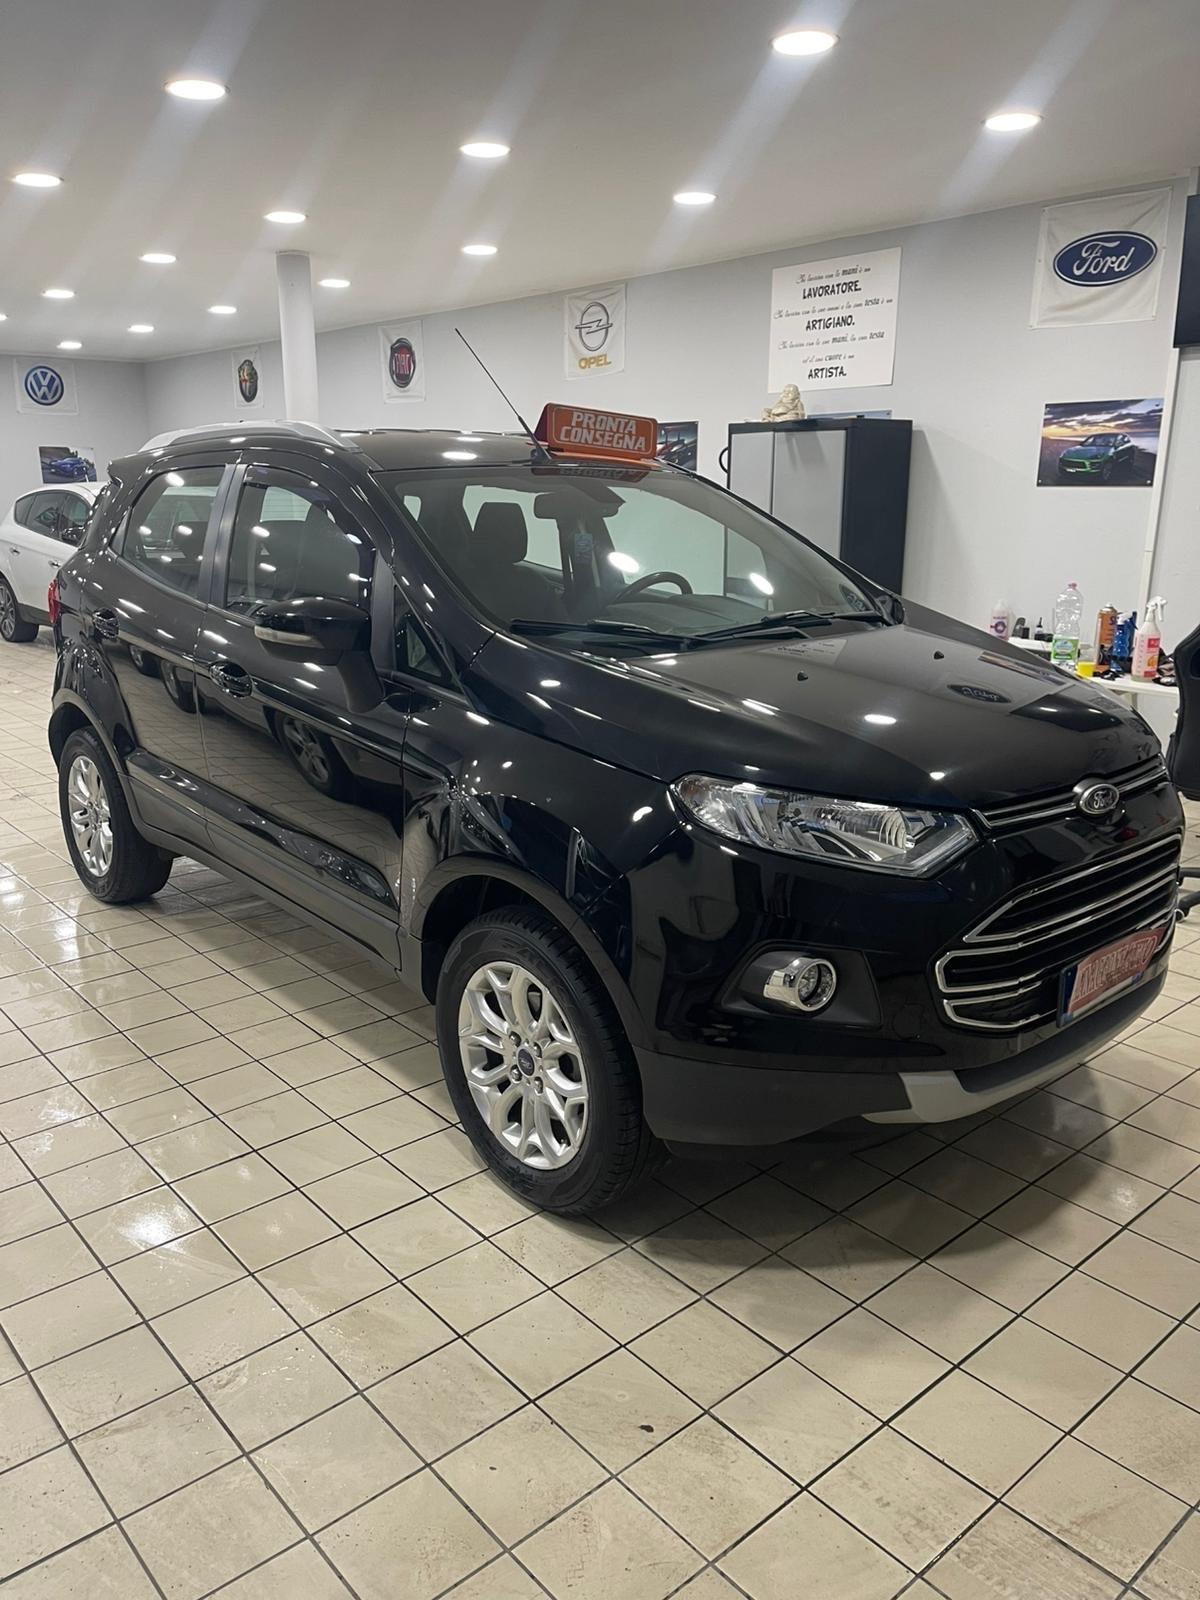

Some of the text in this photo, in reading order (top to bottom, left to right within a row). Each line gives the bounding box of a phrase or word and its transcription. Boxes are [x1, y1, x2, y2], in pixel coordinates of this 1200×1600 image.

[1073, 240, 1135, 276] Ford
[802, 280, 862, 300] LAVORATORE.
[805, 315, 855, 332] ARTIGIANO.
[393, 353, 411, 375] FIAT
[579, 354, 612, 369] OPEL
[807, 366, 847, 380] ARTISTA.
[571, 411, 637, 435] PRONTA
[560, 426, 646, 451] CONSEGNA
